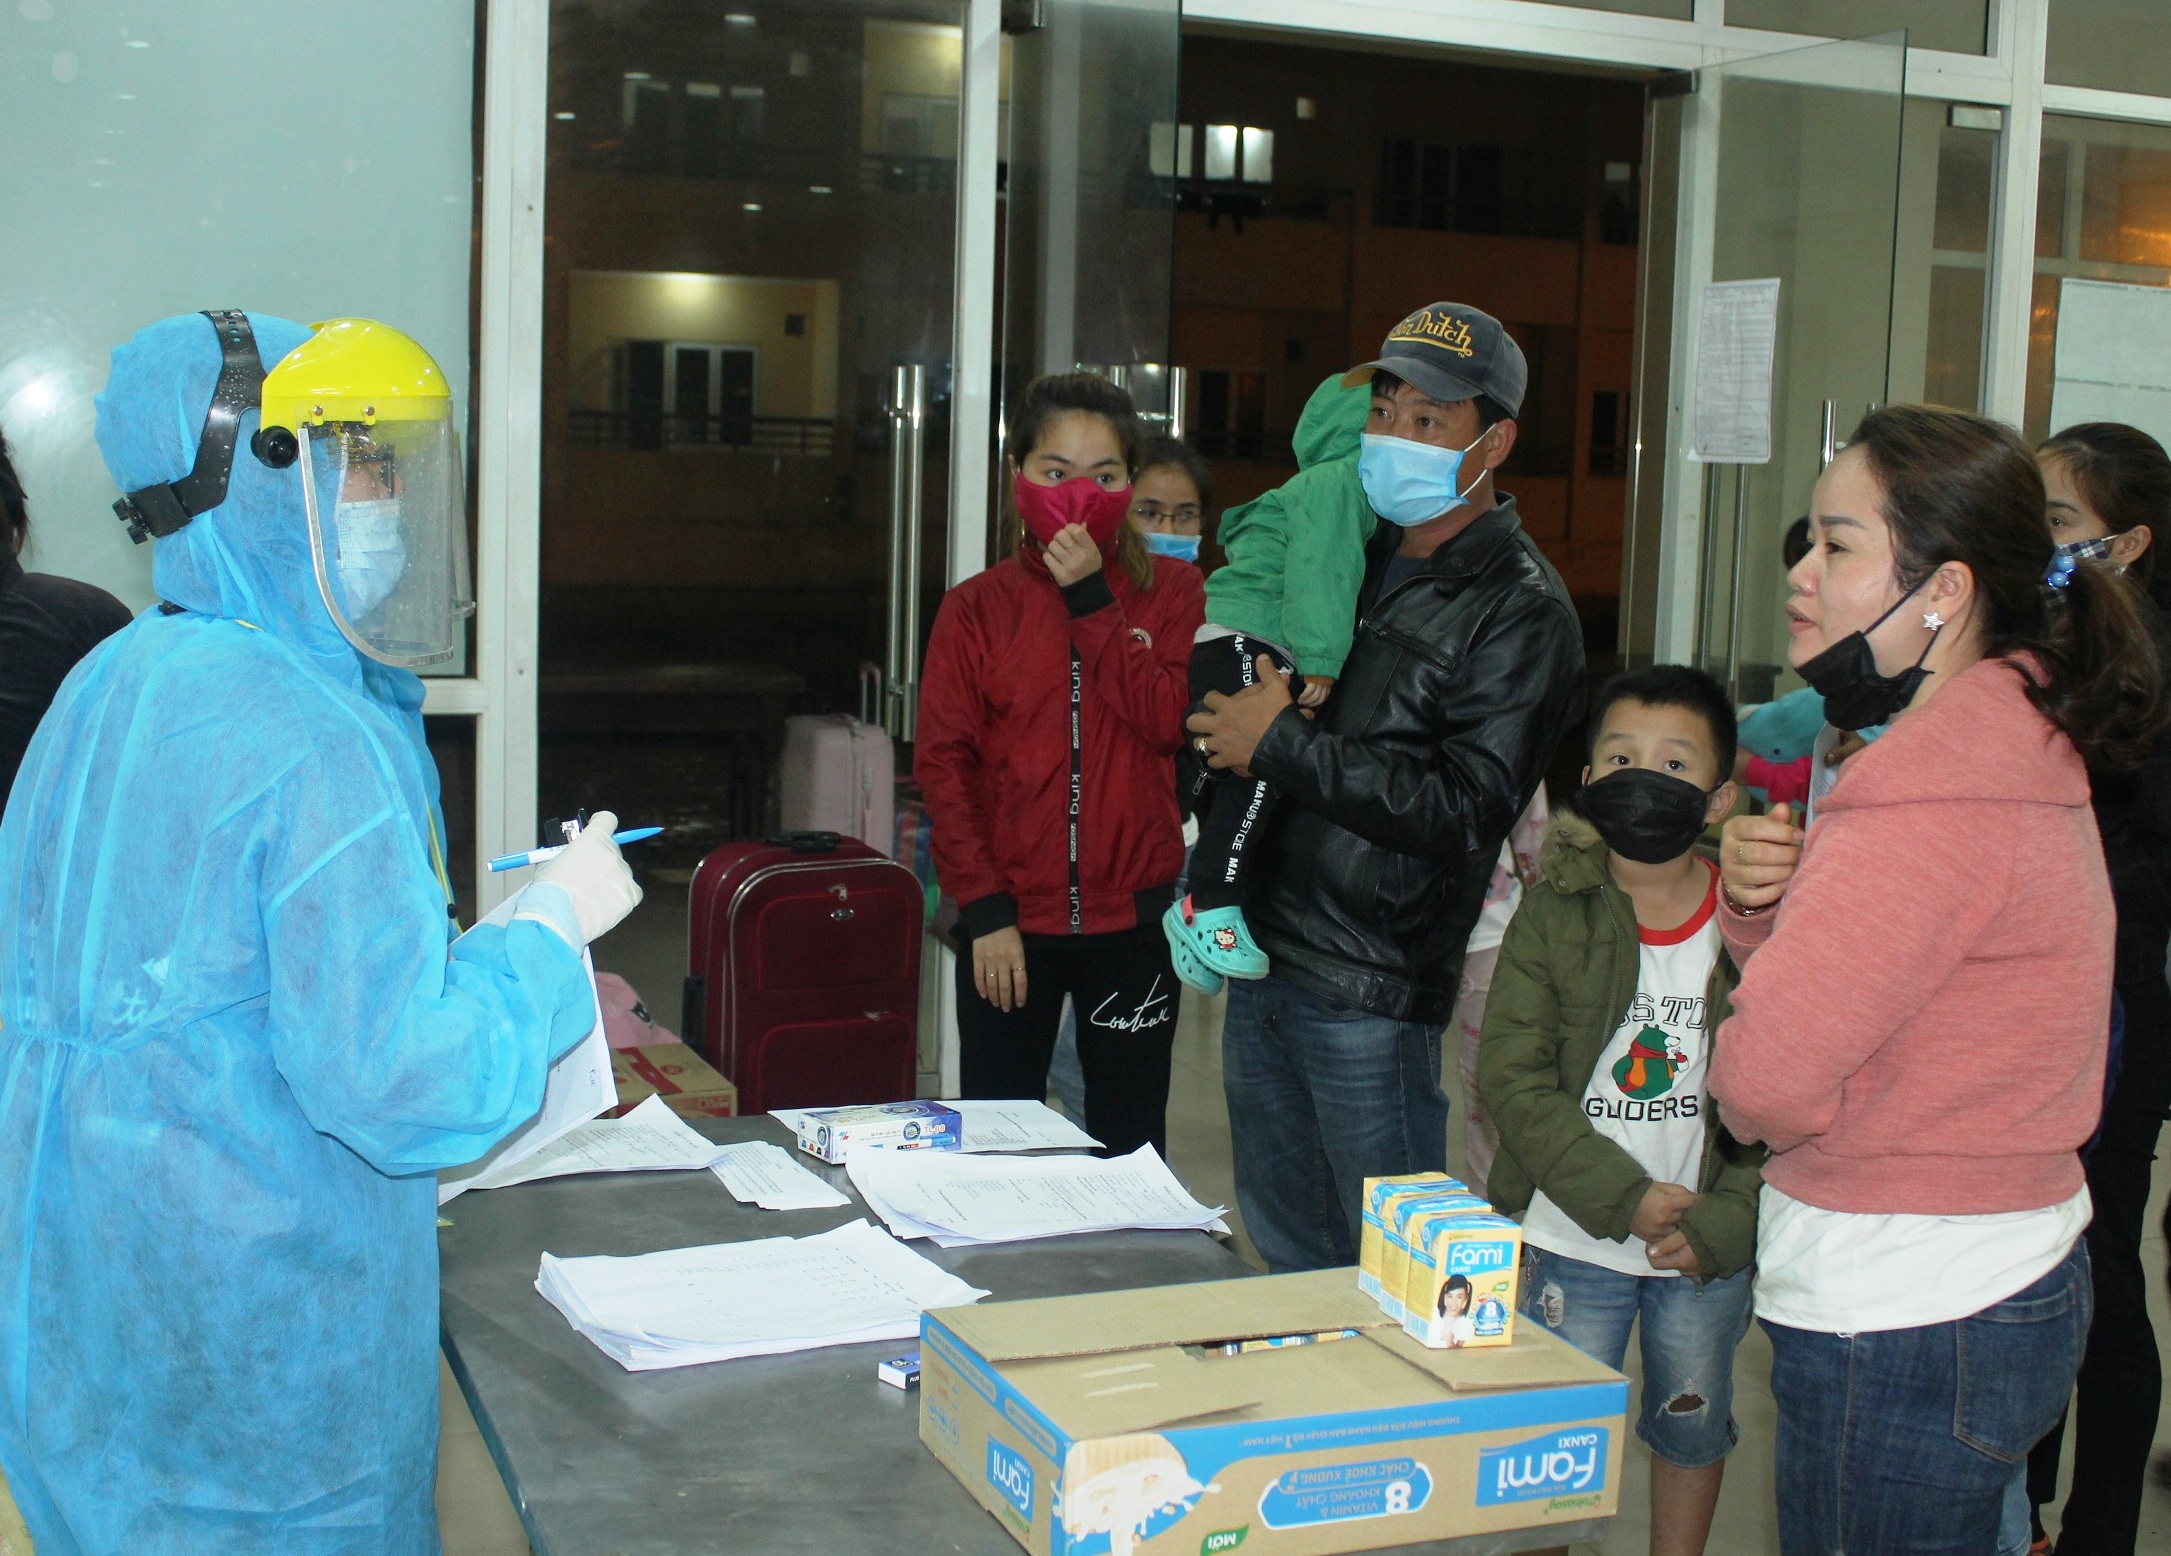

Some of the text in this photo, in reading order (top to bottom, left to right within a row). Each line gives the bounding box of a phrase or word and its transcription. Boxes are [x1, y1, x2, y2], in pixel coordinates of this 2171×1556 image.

[1412, 311, 1473, 351] Dutch
[1071, 661, 1081, 703] king
[1070, 774, 1081, 815] king
[1070, 886, 1081, 925] king
[1617, 992, 1708, 1037] STO
[924, 1123, 946, 1134] TL-08
[1558, 1433, 1598, 1449] CANXI
[1320, 1502, 1379, 1518] VITAMIN &
[1384, 1480, 1412, 1515] 8
[1208, 1532, 1237, 1551] MỚI
